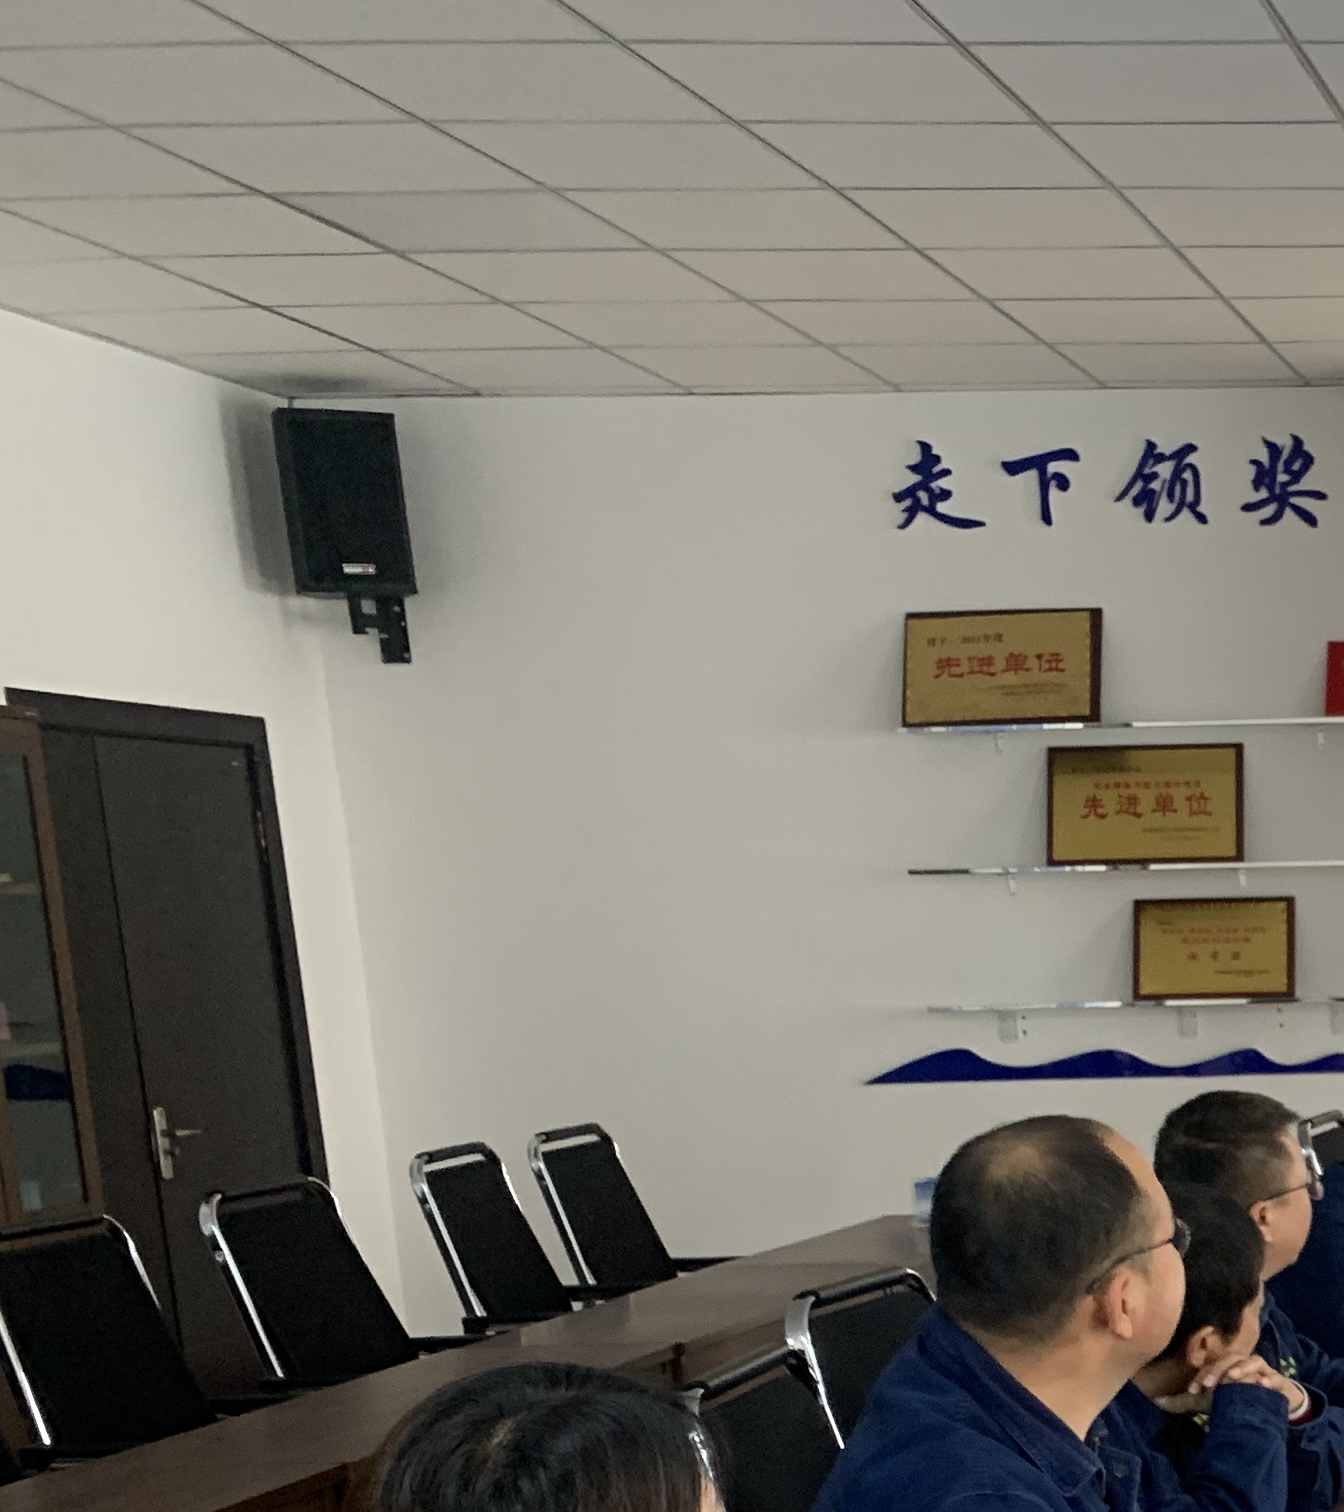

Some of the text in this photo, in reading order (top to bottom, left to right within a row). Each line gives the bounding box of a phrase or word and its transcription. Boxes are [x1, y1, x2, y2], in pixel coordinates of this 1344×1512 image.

[933, 651, 1066, 680] 先进单位
[1079, 791, 1213, 820] 先进单位
